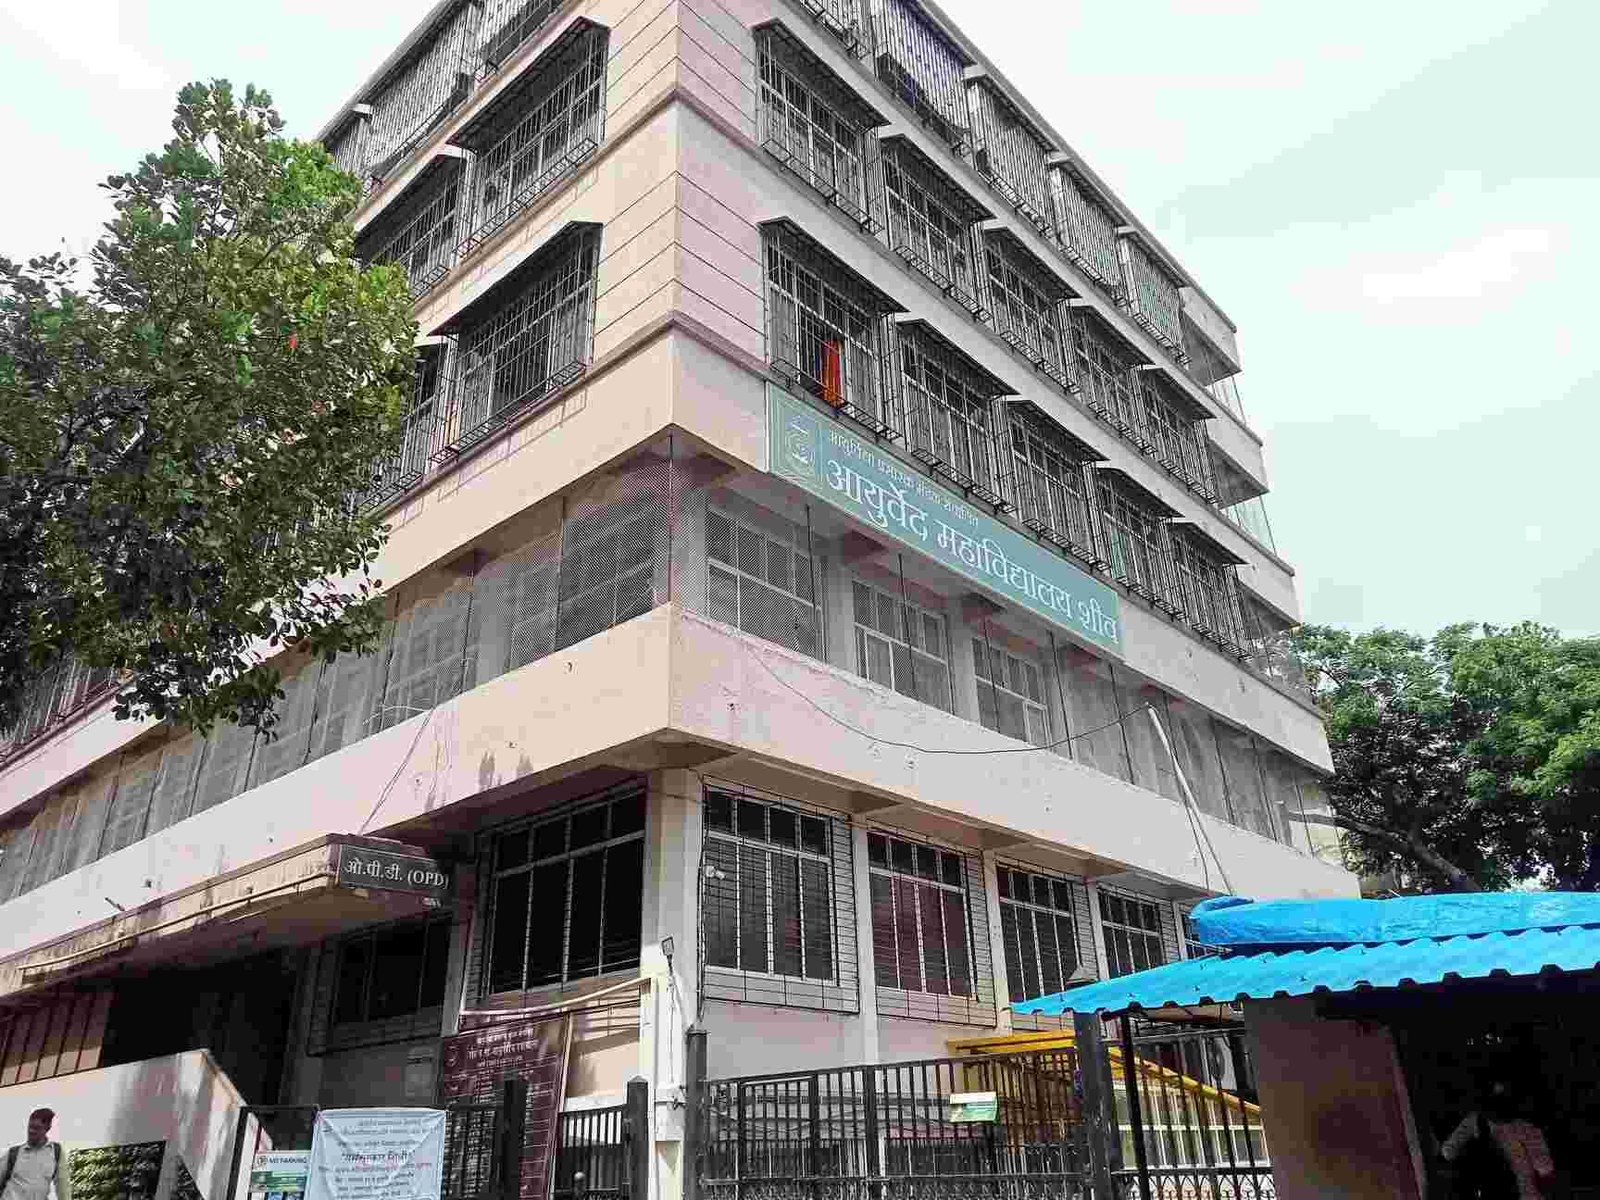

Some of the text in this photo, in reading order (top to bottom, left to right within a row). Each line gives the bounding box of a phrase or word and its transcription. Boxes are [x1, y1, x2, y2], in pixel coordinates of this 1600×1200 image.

[826, 459, 1119, 644] आयुर्वेद महाविद्यालय शीव
[407, 868, 450, 889] (OPD)
